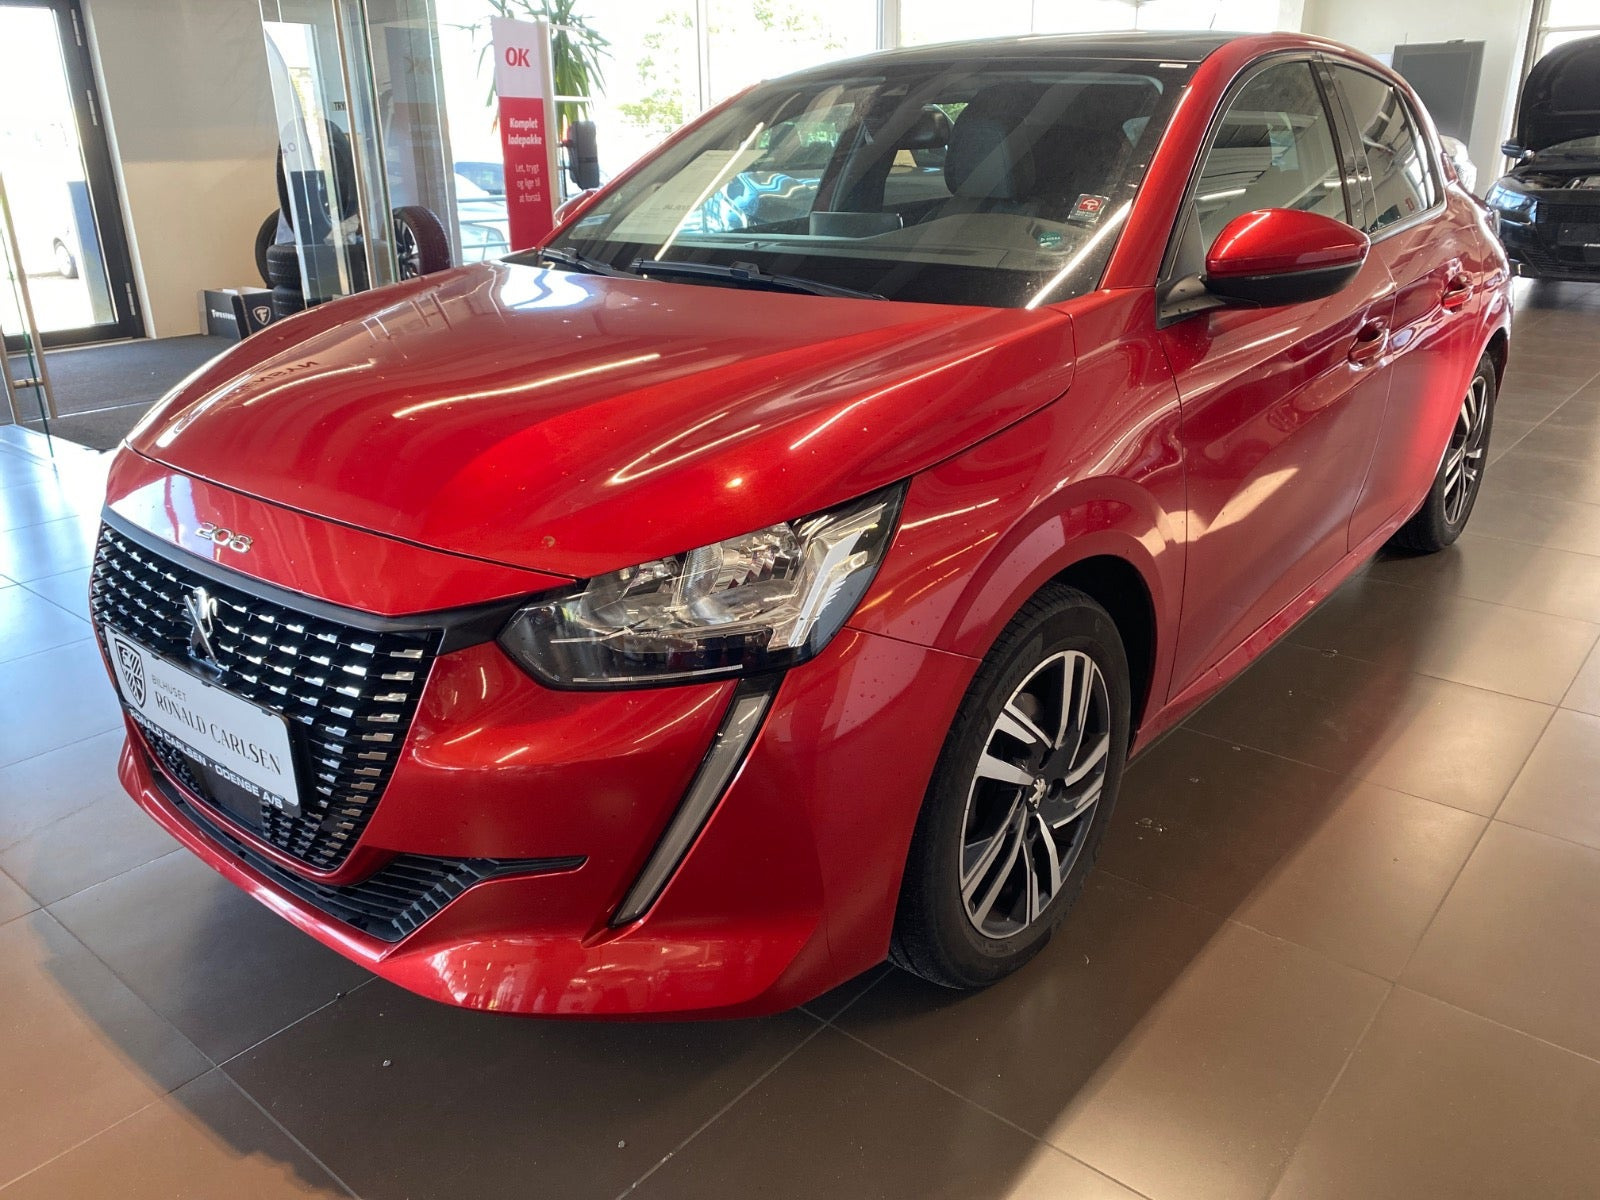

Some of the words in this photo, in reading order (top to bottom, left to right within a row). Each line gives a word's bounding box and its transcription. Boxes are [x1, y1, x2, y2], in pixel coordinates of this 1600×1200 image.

[506, 47, 530, 67] OK
[509, 117, 538, 131] Komplet
[508, 133, 542, 148] ladepakke
[194, 521, 254, 553] 208
[151, 674, 187, 702] BILHUSET
[155, 691, 206, 735] RONALD
[210, 723, 281, 776] CARLSEN
[164, 732, 207, 766] CARLSEN
[214, 764, 260, 797] ODENSE
[262, 791, 283, 809] A/S
